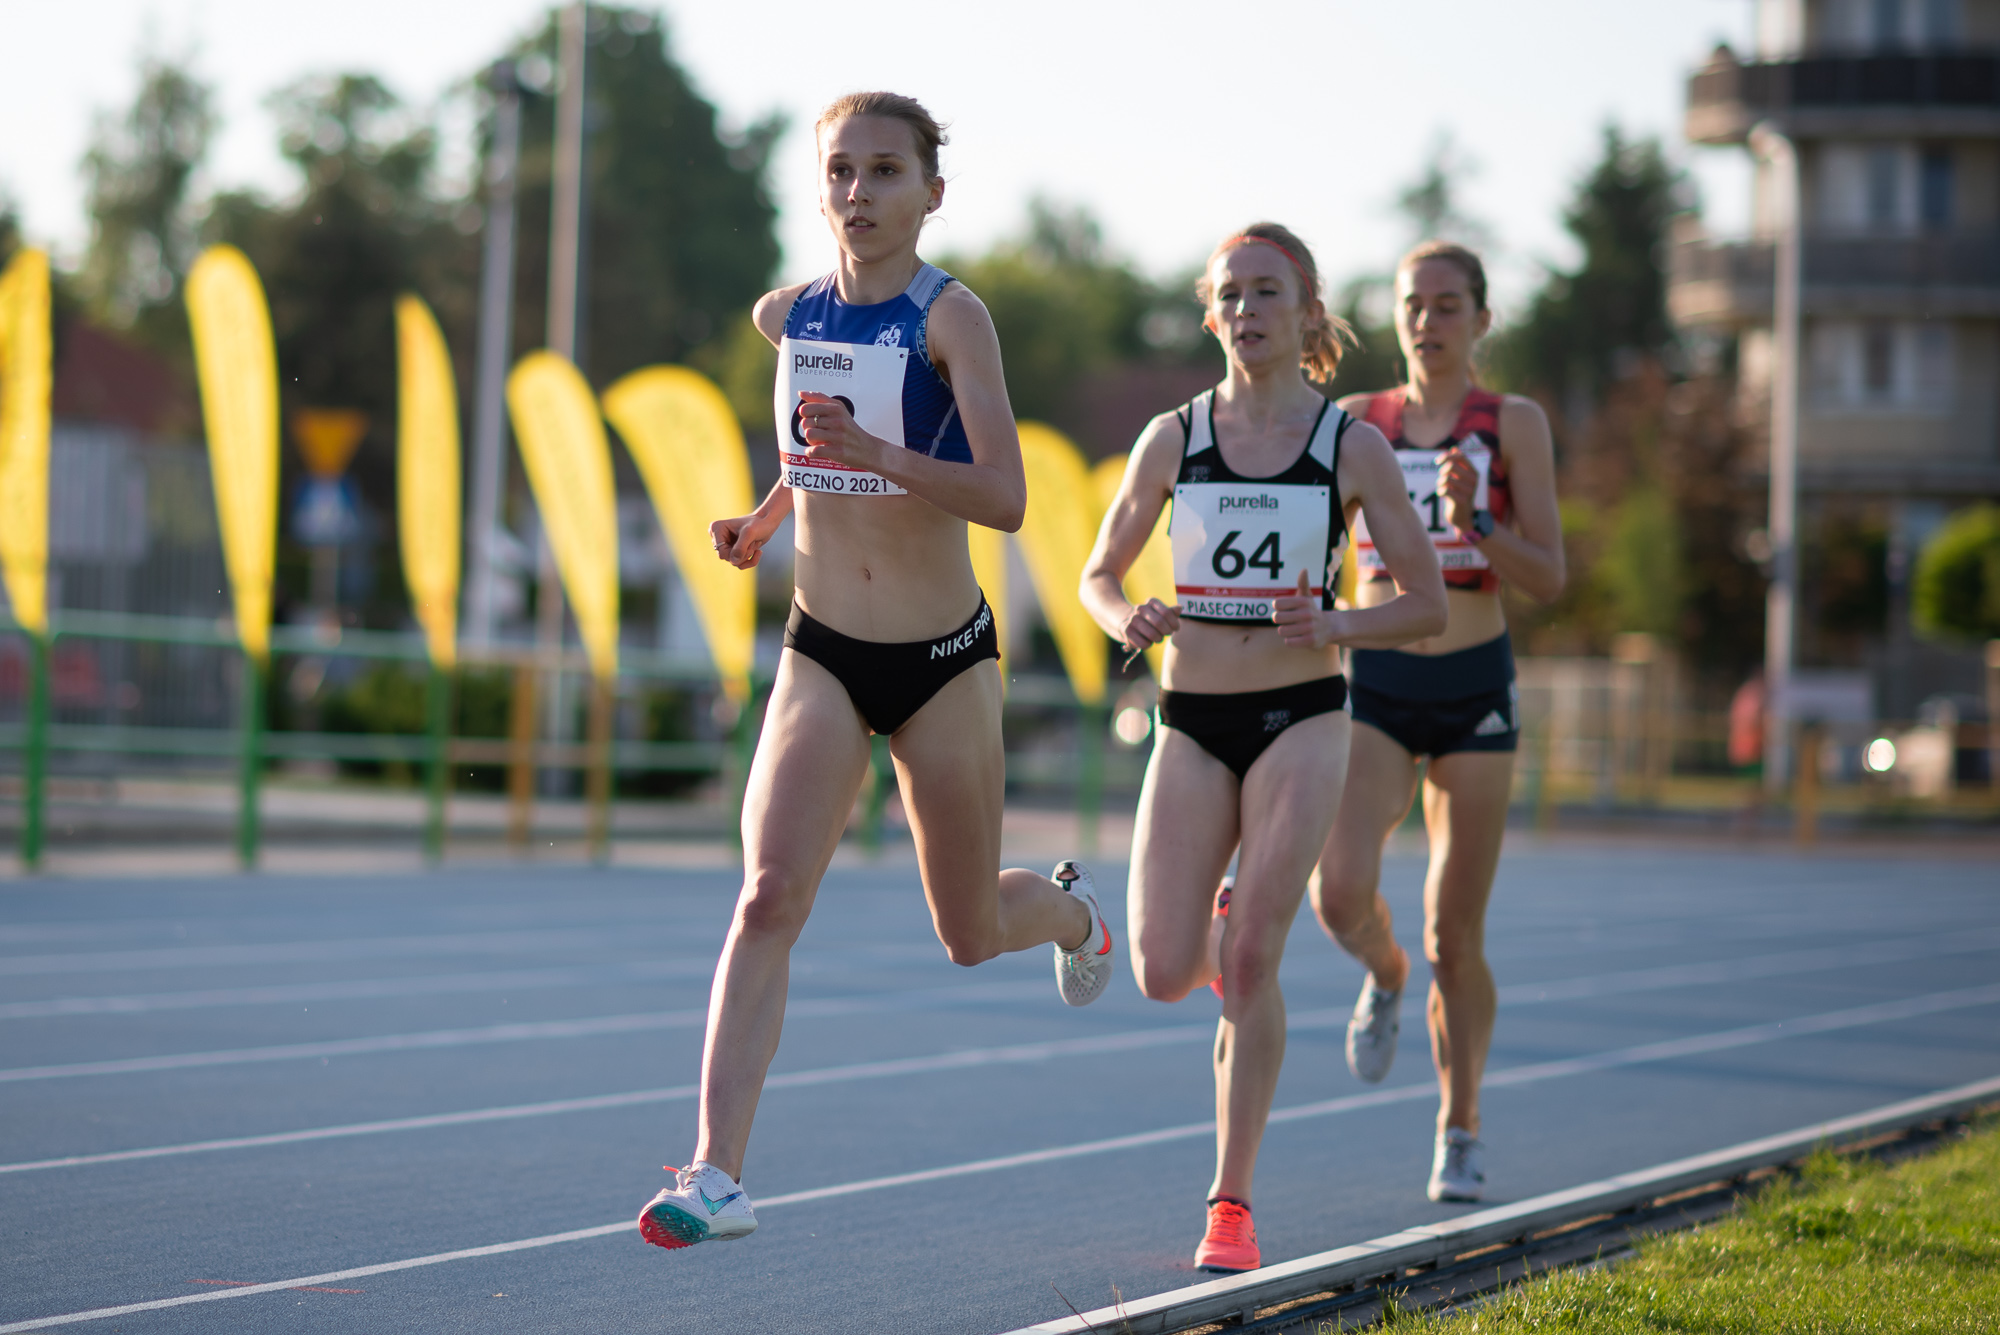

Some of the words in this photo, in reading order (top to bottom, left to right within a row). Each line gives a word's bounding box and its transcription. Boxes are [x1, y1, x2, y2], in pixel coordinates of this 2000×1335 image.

[794, 353, 854, 373] purella
[799, 369, 853, 378] SUPERFOODS
[786, 455, 807, 465] PZLA
[783, 470, 844, 491] ASECZNO
[849, 478, 887, 493] 2021
[1219, 494, 1279, 514] purella
[1212, 530, 1285, 580] 64
[1187, 600, 1269, 616] PIASECZNO
[930, 627, 974, 660] NIKE
[974, 603, 991, 639] PRO
